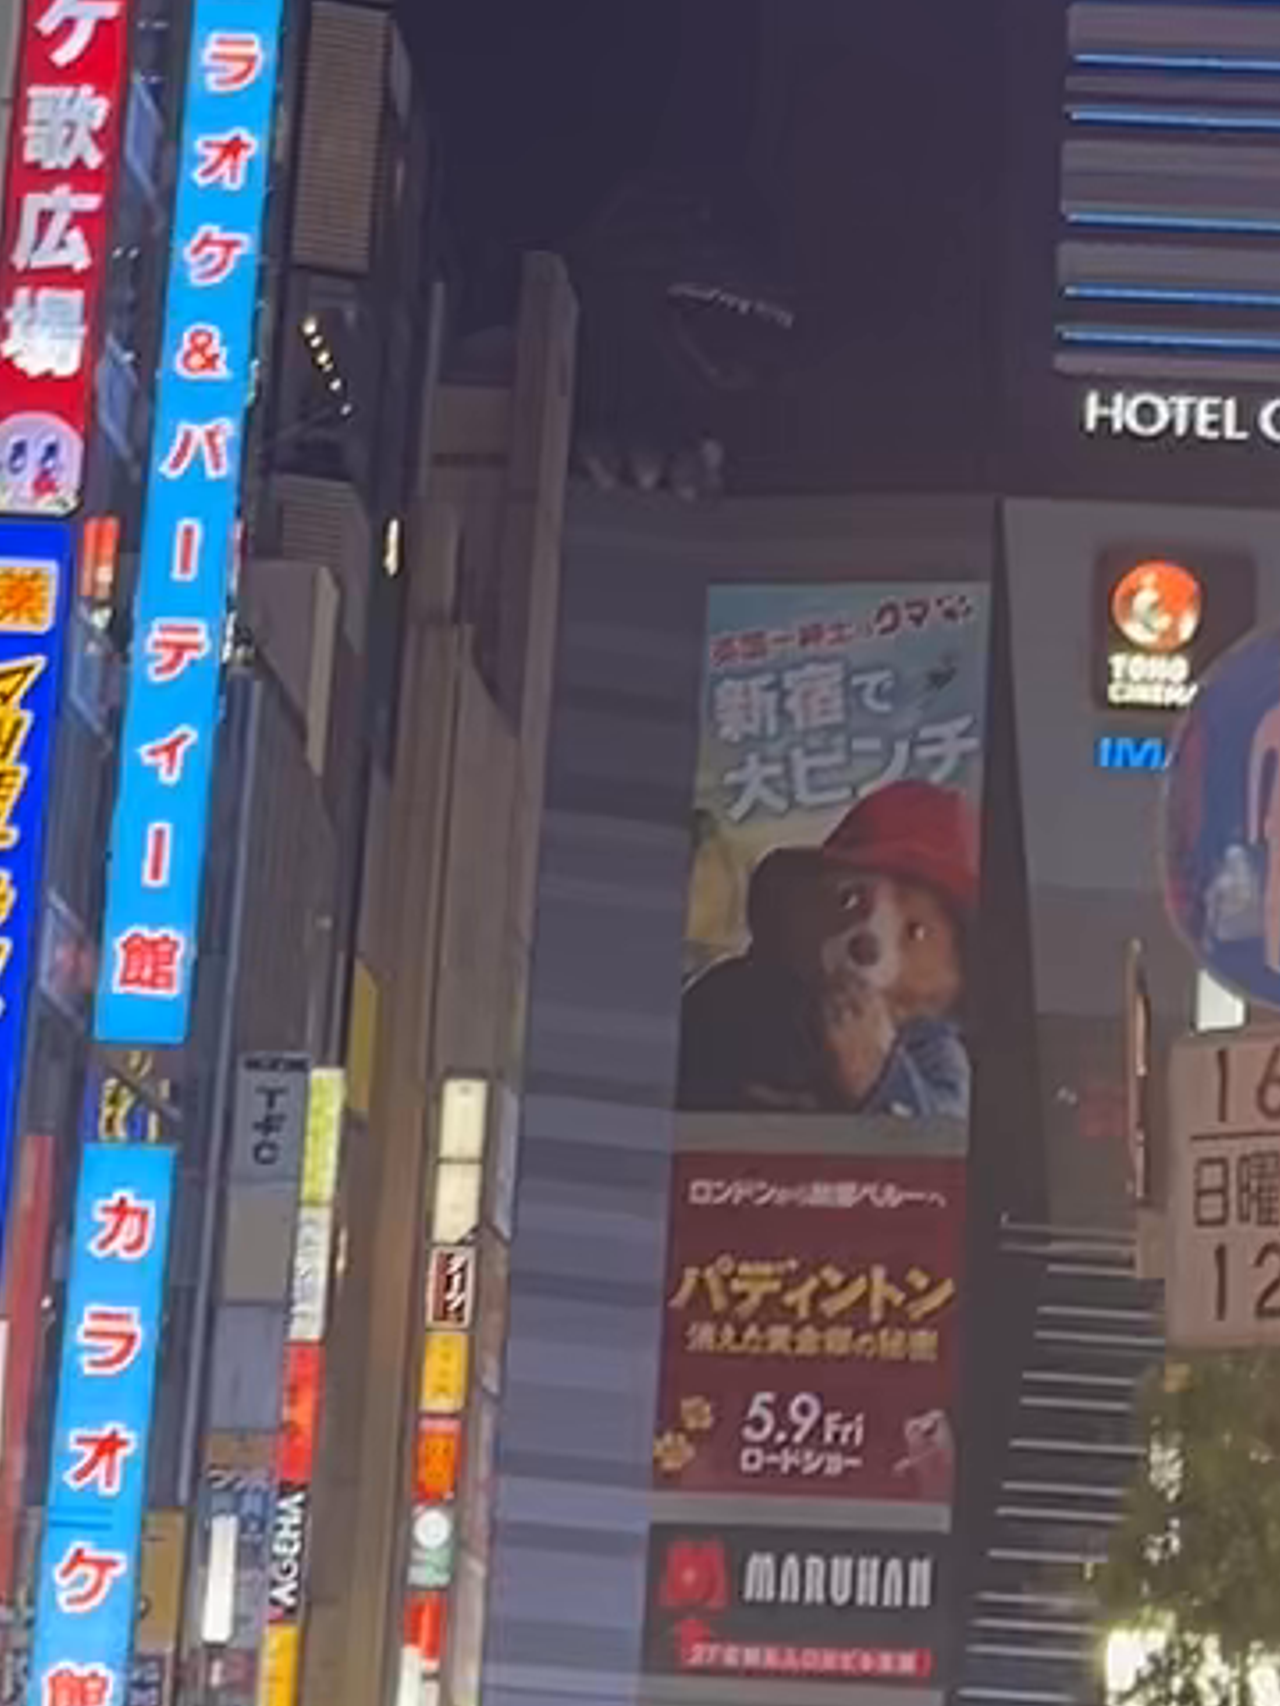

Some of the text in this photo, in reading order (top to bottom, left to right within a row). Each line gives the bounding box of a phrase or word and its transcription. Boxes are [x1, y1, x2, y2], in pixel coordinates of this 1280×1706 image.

[1084, 390, 1248, 441] HOTEL
[668, 1254, 956, 1324] パディントン
[741, 1391, 866, 1446] 5.9 Fri
[740, 1446, 864, 1477] ロードショー
[743, 1551, 933, 1608] MARUHAN
